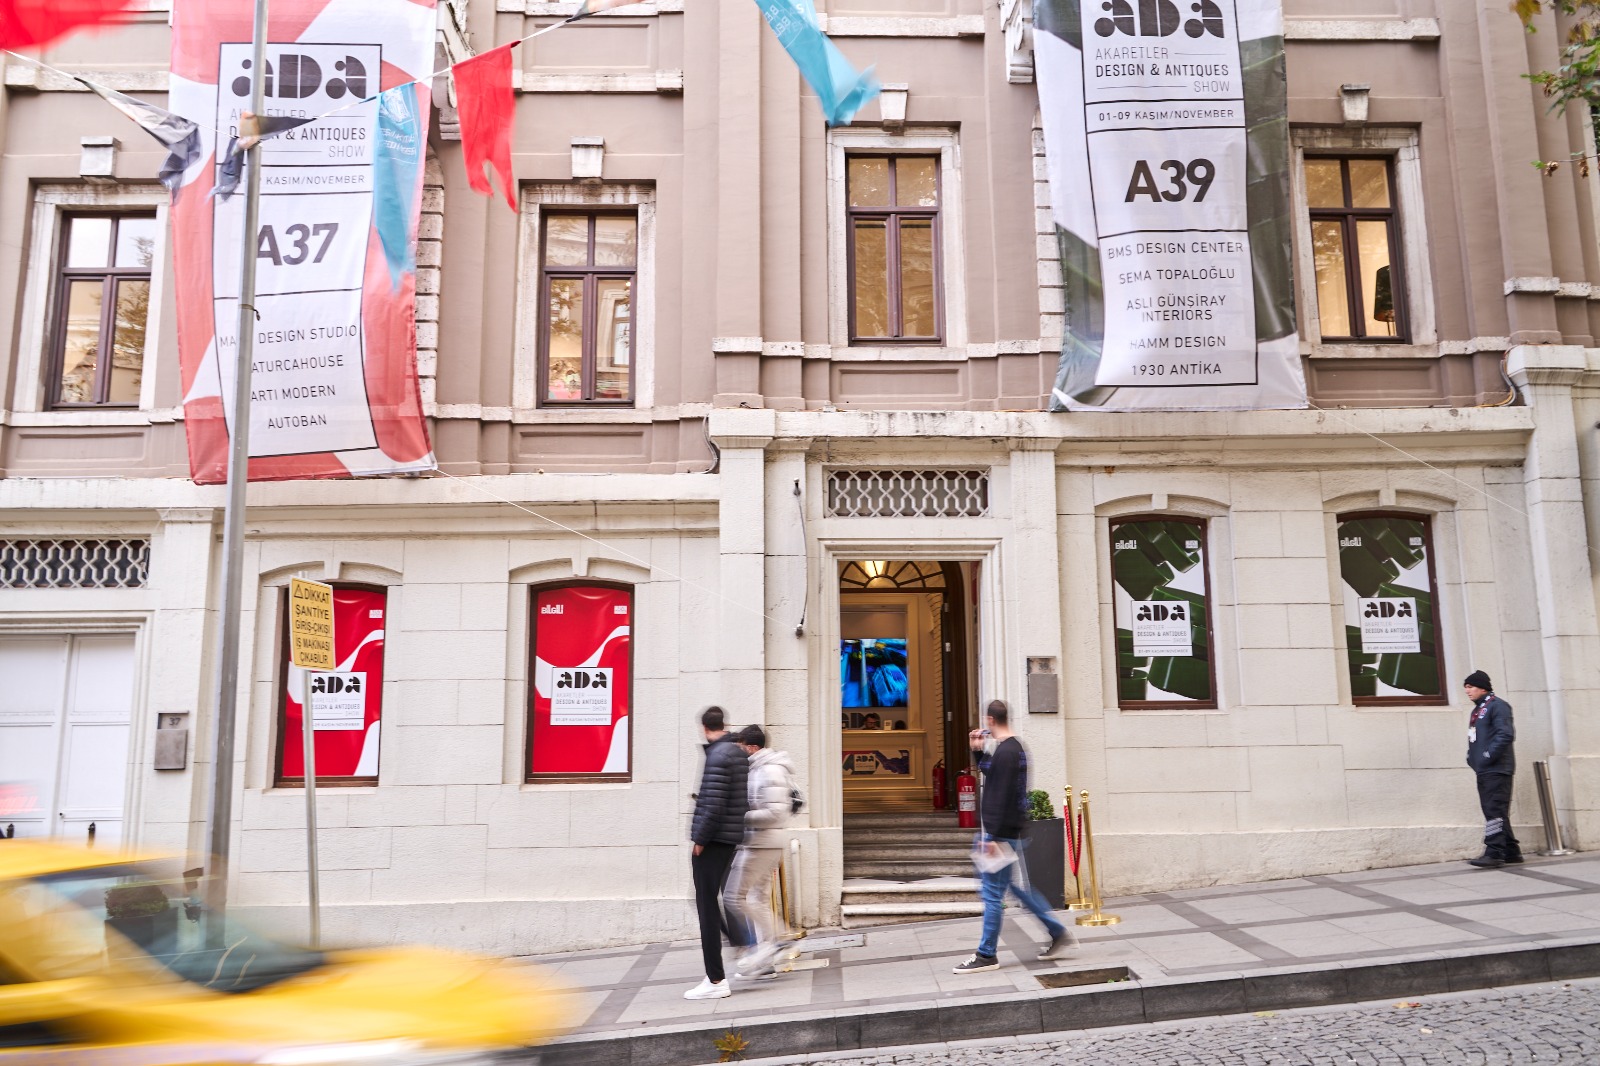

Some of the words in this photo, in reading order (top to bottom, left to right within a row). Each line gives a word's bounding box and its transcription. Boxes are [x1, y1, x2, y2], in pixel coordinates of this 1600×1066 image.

[1096, 46, 1168, 60] AKARETLER
[1096, 64, 1144, 78] DESIGN
[1150, 64, 1160, 76] &
[1165, 64, 1229, 77] ANTIQUES
[1194, 80, 1230, 92] SHOW
[1099, 111, 1130, 122] 01-09
[1135, 109, 1234, 121] KASIM/NOVEMBER
[286, 128, 296, 139] &
[301, 127, 366, 140] ANTIQUES
[328, 145, 365, 158] SHOW
[266, 174, 365, 185] KASIM/NOVEMBER
[1125, 158, 1216, 203] A39
[256, 223, 339, 266] A37
[1108, 245, 1132, 259] BMS
[1136, 242, 1186, 254] DESIGN
[1192, 241, 1244, 253] CENTER
[1119, 270, 1152, 284] SEMA
[1156, 265, 1235, 280] TOPALOĞLU
[1126, 297, 1152, 310] ASLI
[1142, 309, 1213, 322] INTERIORS
[258, 329, 305, 344] DESIGN
[310, 324, 357, 340] STUDIO
[1130, 337, 1168, 350] HAMM
[1175, 336, 1226, 348] DESIGN
[251, 354, 344, 374] ATURCAHOUSE
[1132, 365, 1164, 376] 1930
[1170, 361, 1222, 375] ANTİKA
[283, 385, 336, 400] MODERN
[268, 414, 327, 429] AUTOBAN
[304, 587, 330, 604] DİKKAT
[296, 604, 329, 620] ŞANTİYE
[169, 717, 181, 726] 37
